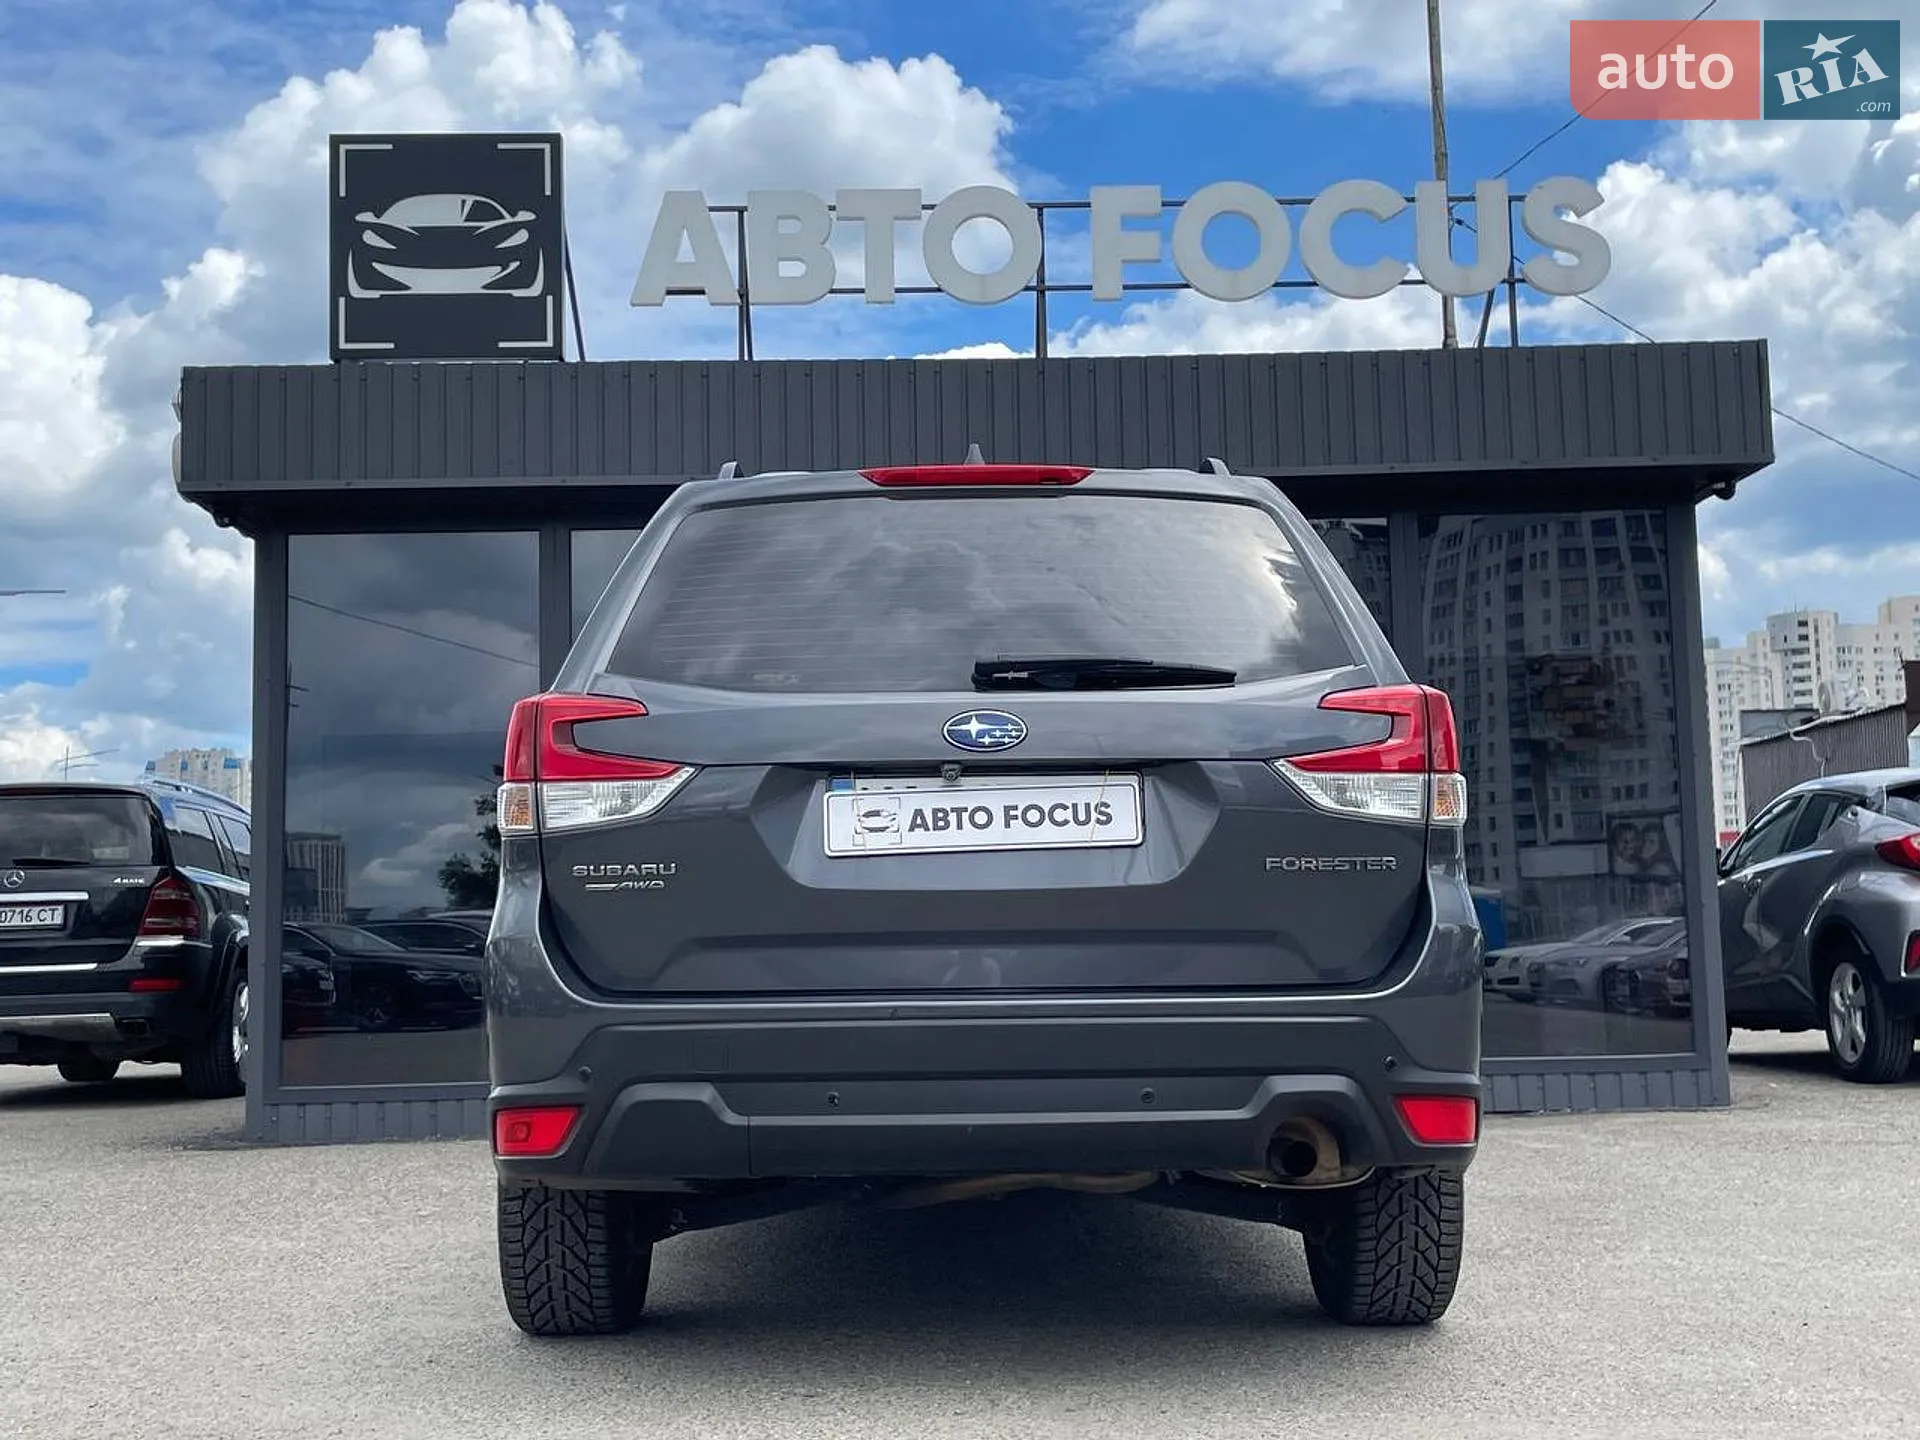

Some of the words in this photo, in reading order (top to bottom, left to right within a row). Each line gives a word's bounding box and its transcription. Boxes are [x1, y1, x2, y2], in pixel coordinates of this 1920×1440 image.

[630, 185, 1043, 306] АВТО
[1090, 176, 1612, 301] FOCUS
[908, 805, 994, 833] АВТО
[1003, 801, 1113, 829] FOCUS
[572, 863, 677, 877] SUBARU
[1265, 857, 1397, 871] FORESTER
